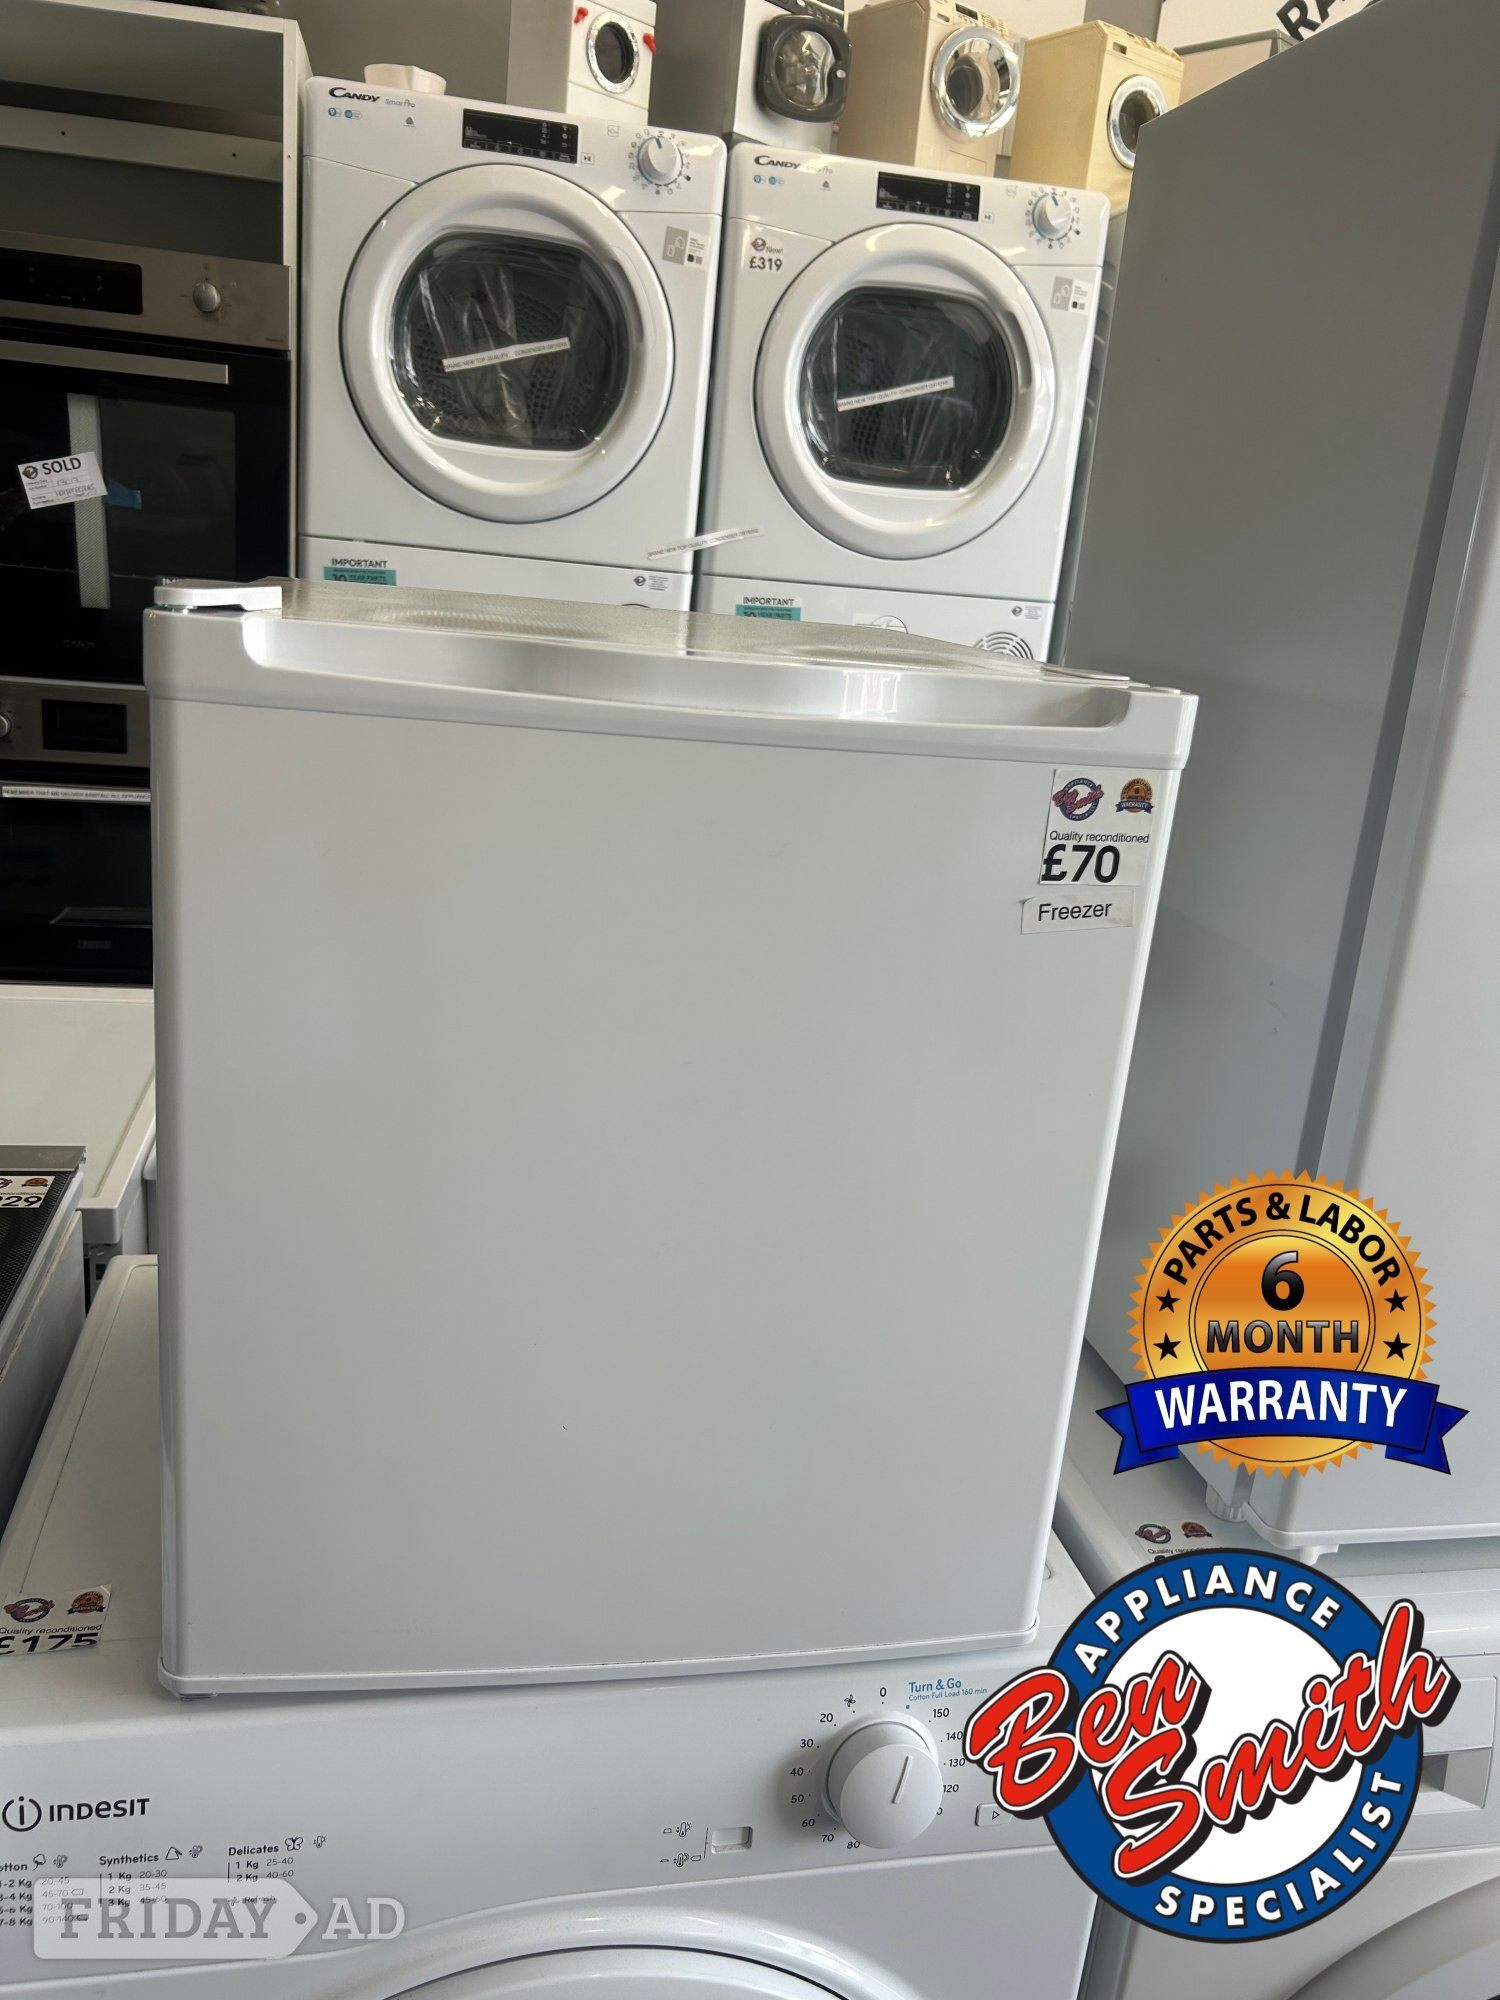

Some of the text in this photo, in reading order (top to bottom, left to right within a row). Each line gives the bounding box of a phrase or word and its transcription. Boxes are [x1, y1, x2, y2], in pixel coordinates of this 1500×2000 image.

[329, 87, 380, 102] CANDY
[754, 155, 800, 169] CANDY
[749, 256, 783, 271] £319
[42, 457, 82, 475] SOLD
[331, 558, 388, 568] IMPORTANT
[743, 596, 795, 606] IMPORTANT
[1050, 830, 1149, 843] Quality reconditioned
[1041, 844, 1120, 883] £70
[1038, 903, 1112, 921] Freezer
[36, 1624, 102, 1634] reconditioned
[909, 1678, 961, 1693] Turn & Go
[880, 1687, 887, 1697] 0
[933, 1707, 949, 1718] 150
[820, 1713, 833, 1723] 20
[946, 1731, 963, 1741] 140
[800, 1738, 814, 1748] 30
[949, 1758, 965, 1767] 130
[790, 1767, 804, 1777] 40
[943, 1784, 959, 1792] 120
[791, 1794, 804, 1804] 50
[802, 1818, 815, 1828] 60
[822, 1834, 834, 1843] 70
[847, 1841, 860, 1849] 80
[228, 1845, 279, 1856] Delicates
[99, 1853, 159, 1867] Synthetics
[246, 1861, 259, 1870] Kg
[266, 1857, 294, 1866] 25-40
[0, 1862, 27, 1872] otton
[119, 1872, 132, 1881] Kg
[139, 1869, 168, 1878] 20-30
[245, 1874, 258, 1882] Kg
[266, 1870, 294, 1879] 40-60
[18, 1879, 32, 1888] Kg
[118, 1885, 131, 1894] Kg
[19, 1892, 32, 1901] Kg
[20, 1904, 33, 1914] Kg
[20, 1917, 33, 1927] Kg
